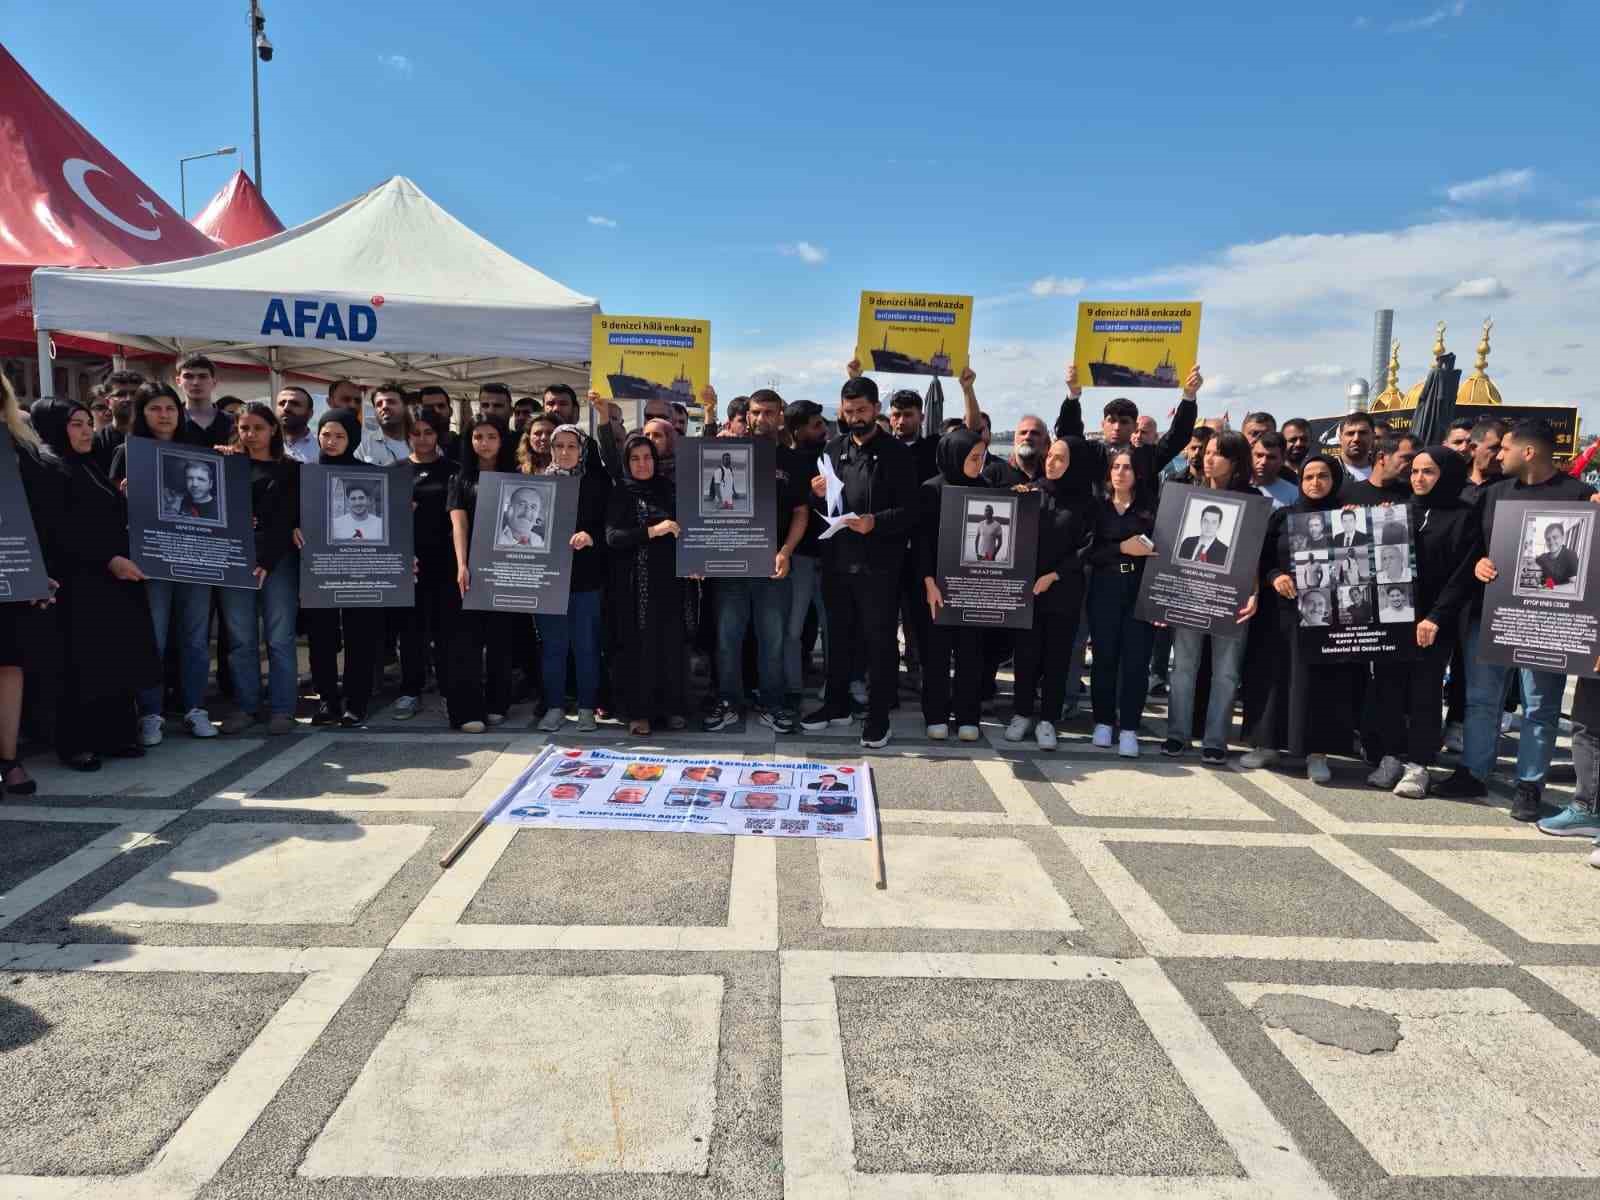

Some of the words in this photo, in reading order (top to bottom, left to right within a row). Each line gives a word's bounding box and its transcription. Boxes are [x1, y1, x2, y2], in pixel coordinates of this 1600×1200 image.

[1094, 308, 1128, 317] denizci
[1151, 308, 1191, 317] enkazda
[260, 298, 378, 342] AFAD
[609, 321, 641, 331] denizci
[664, 323, 702, 333] enkazda
